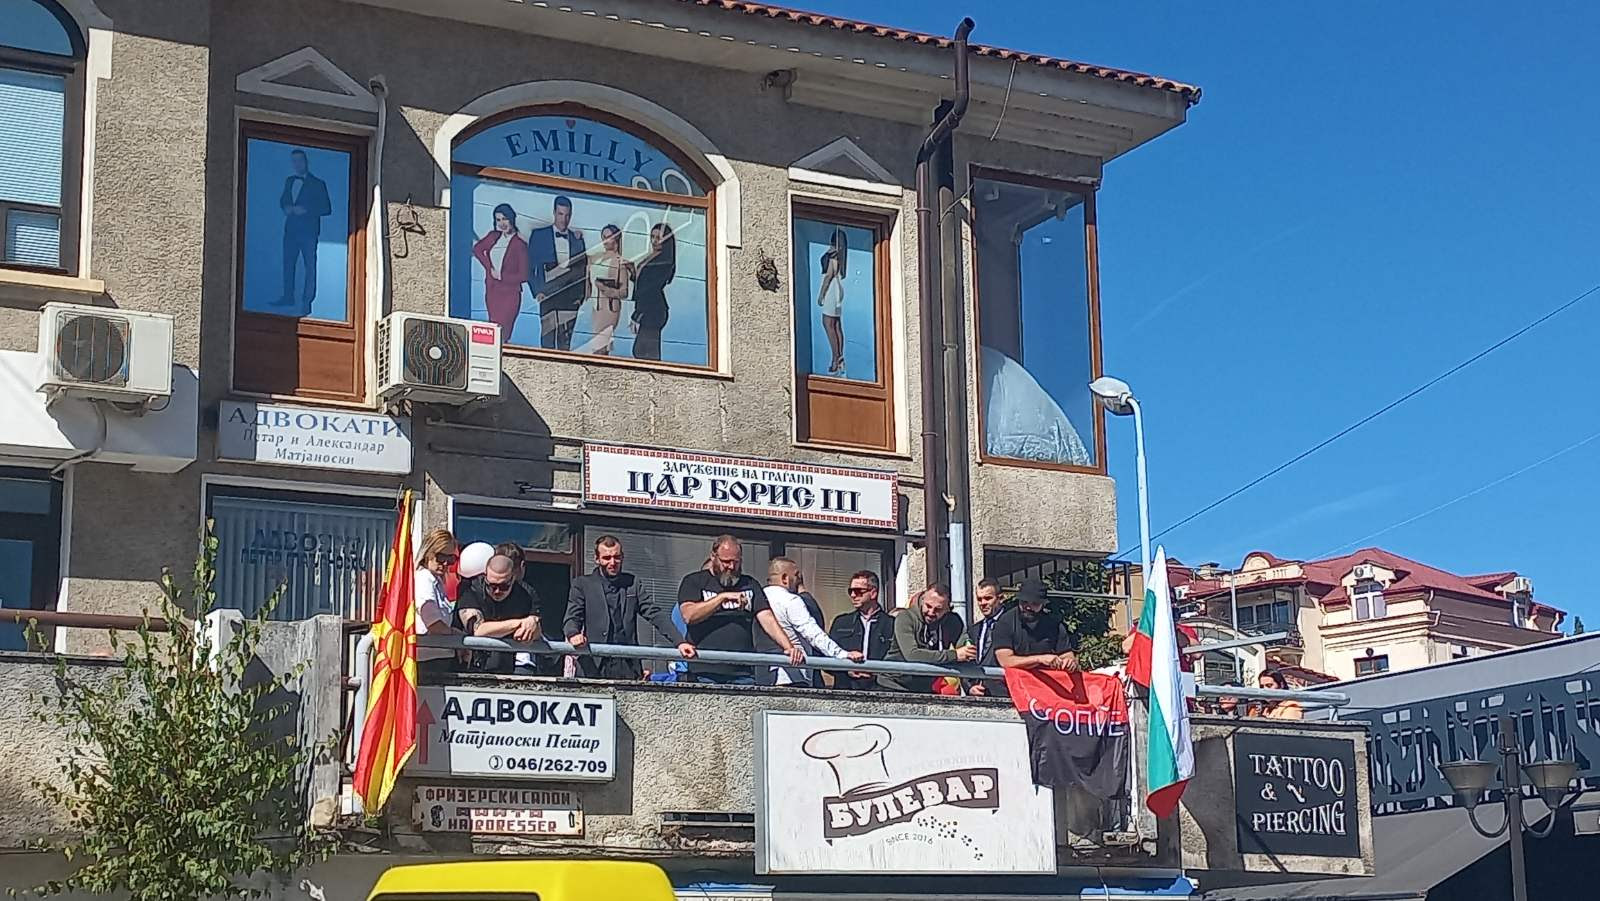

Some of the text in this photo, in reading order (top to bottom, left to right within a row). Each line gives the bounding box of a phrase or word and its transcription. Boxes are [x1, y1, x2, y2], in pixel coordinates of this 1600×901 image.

[540, 158, 618, 183] BUTIK
[228, 407, 403, 438] АДВОКАТИ
[274, 447, 355, 464] Матјаноски
[305, 434, 385, 455] Александар
[741, 469, 758, 479] НА
[627, 470, 702, 504] ЦАР
[708, 478, 816, 509] БОРИС
[441, 696, 603, 727] АДВОКАТ
[506, 757, 608, 773] 046/262-709
[1248, 754, 1345, 797] TATTOO
[425, 788, 570, 806] ФРИЗЕРСКИ САЛОН
[826, 774, 995, 829] БУЛЕВАР
[1261, 782, 1278, 801] &
[448, 818, 557, 833] HAIRDRESSER
[1251, 800, 1347, 835] PIERCING
